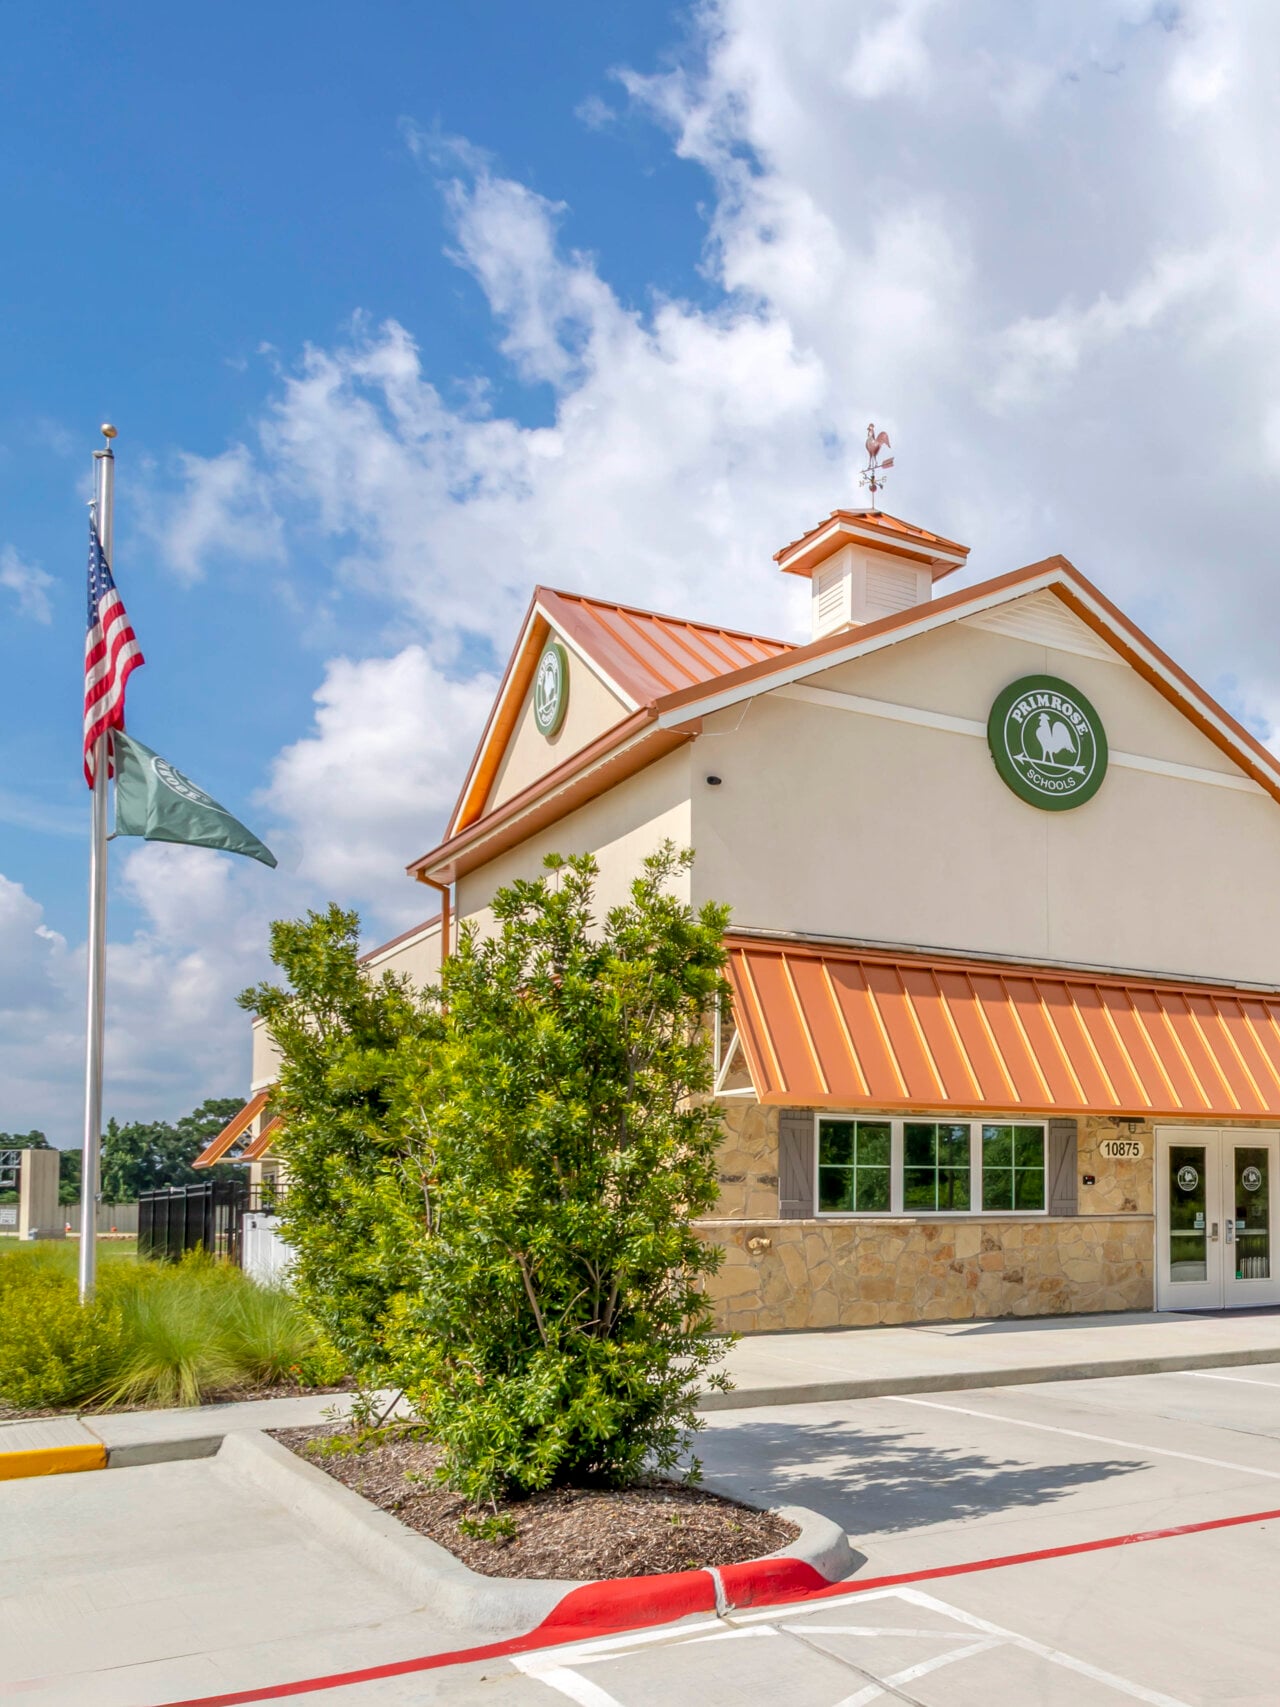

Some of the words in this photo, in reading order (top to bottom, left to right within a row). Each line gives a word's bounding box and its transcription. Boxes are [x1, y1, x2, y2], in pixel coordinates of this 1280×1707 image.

[1011, 694, 1088, 735] PRIMROSE
[1026, 769, 1076, 790] SCHOOLS
[1104, 1142, 1139, 1156] 10875
